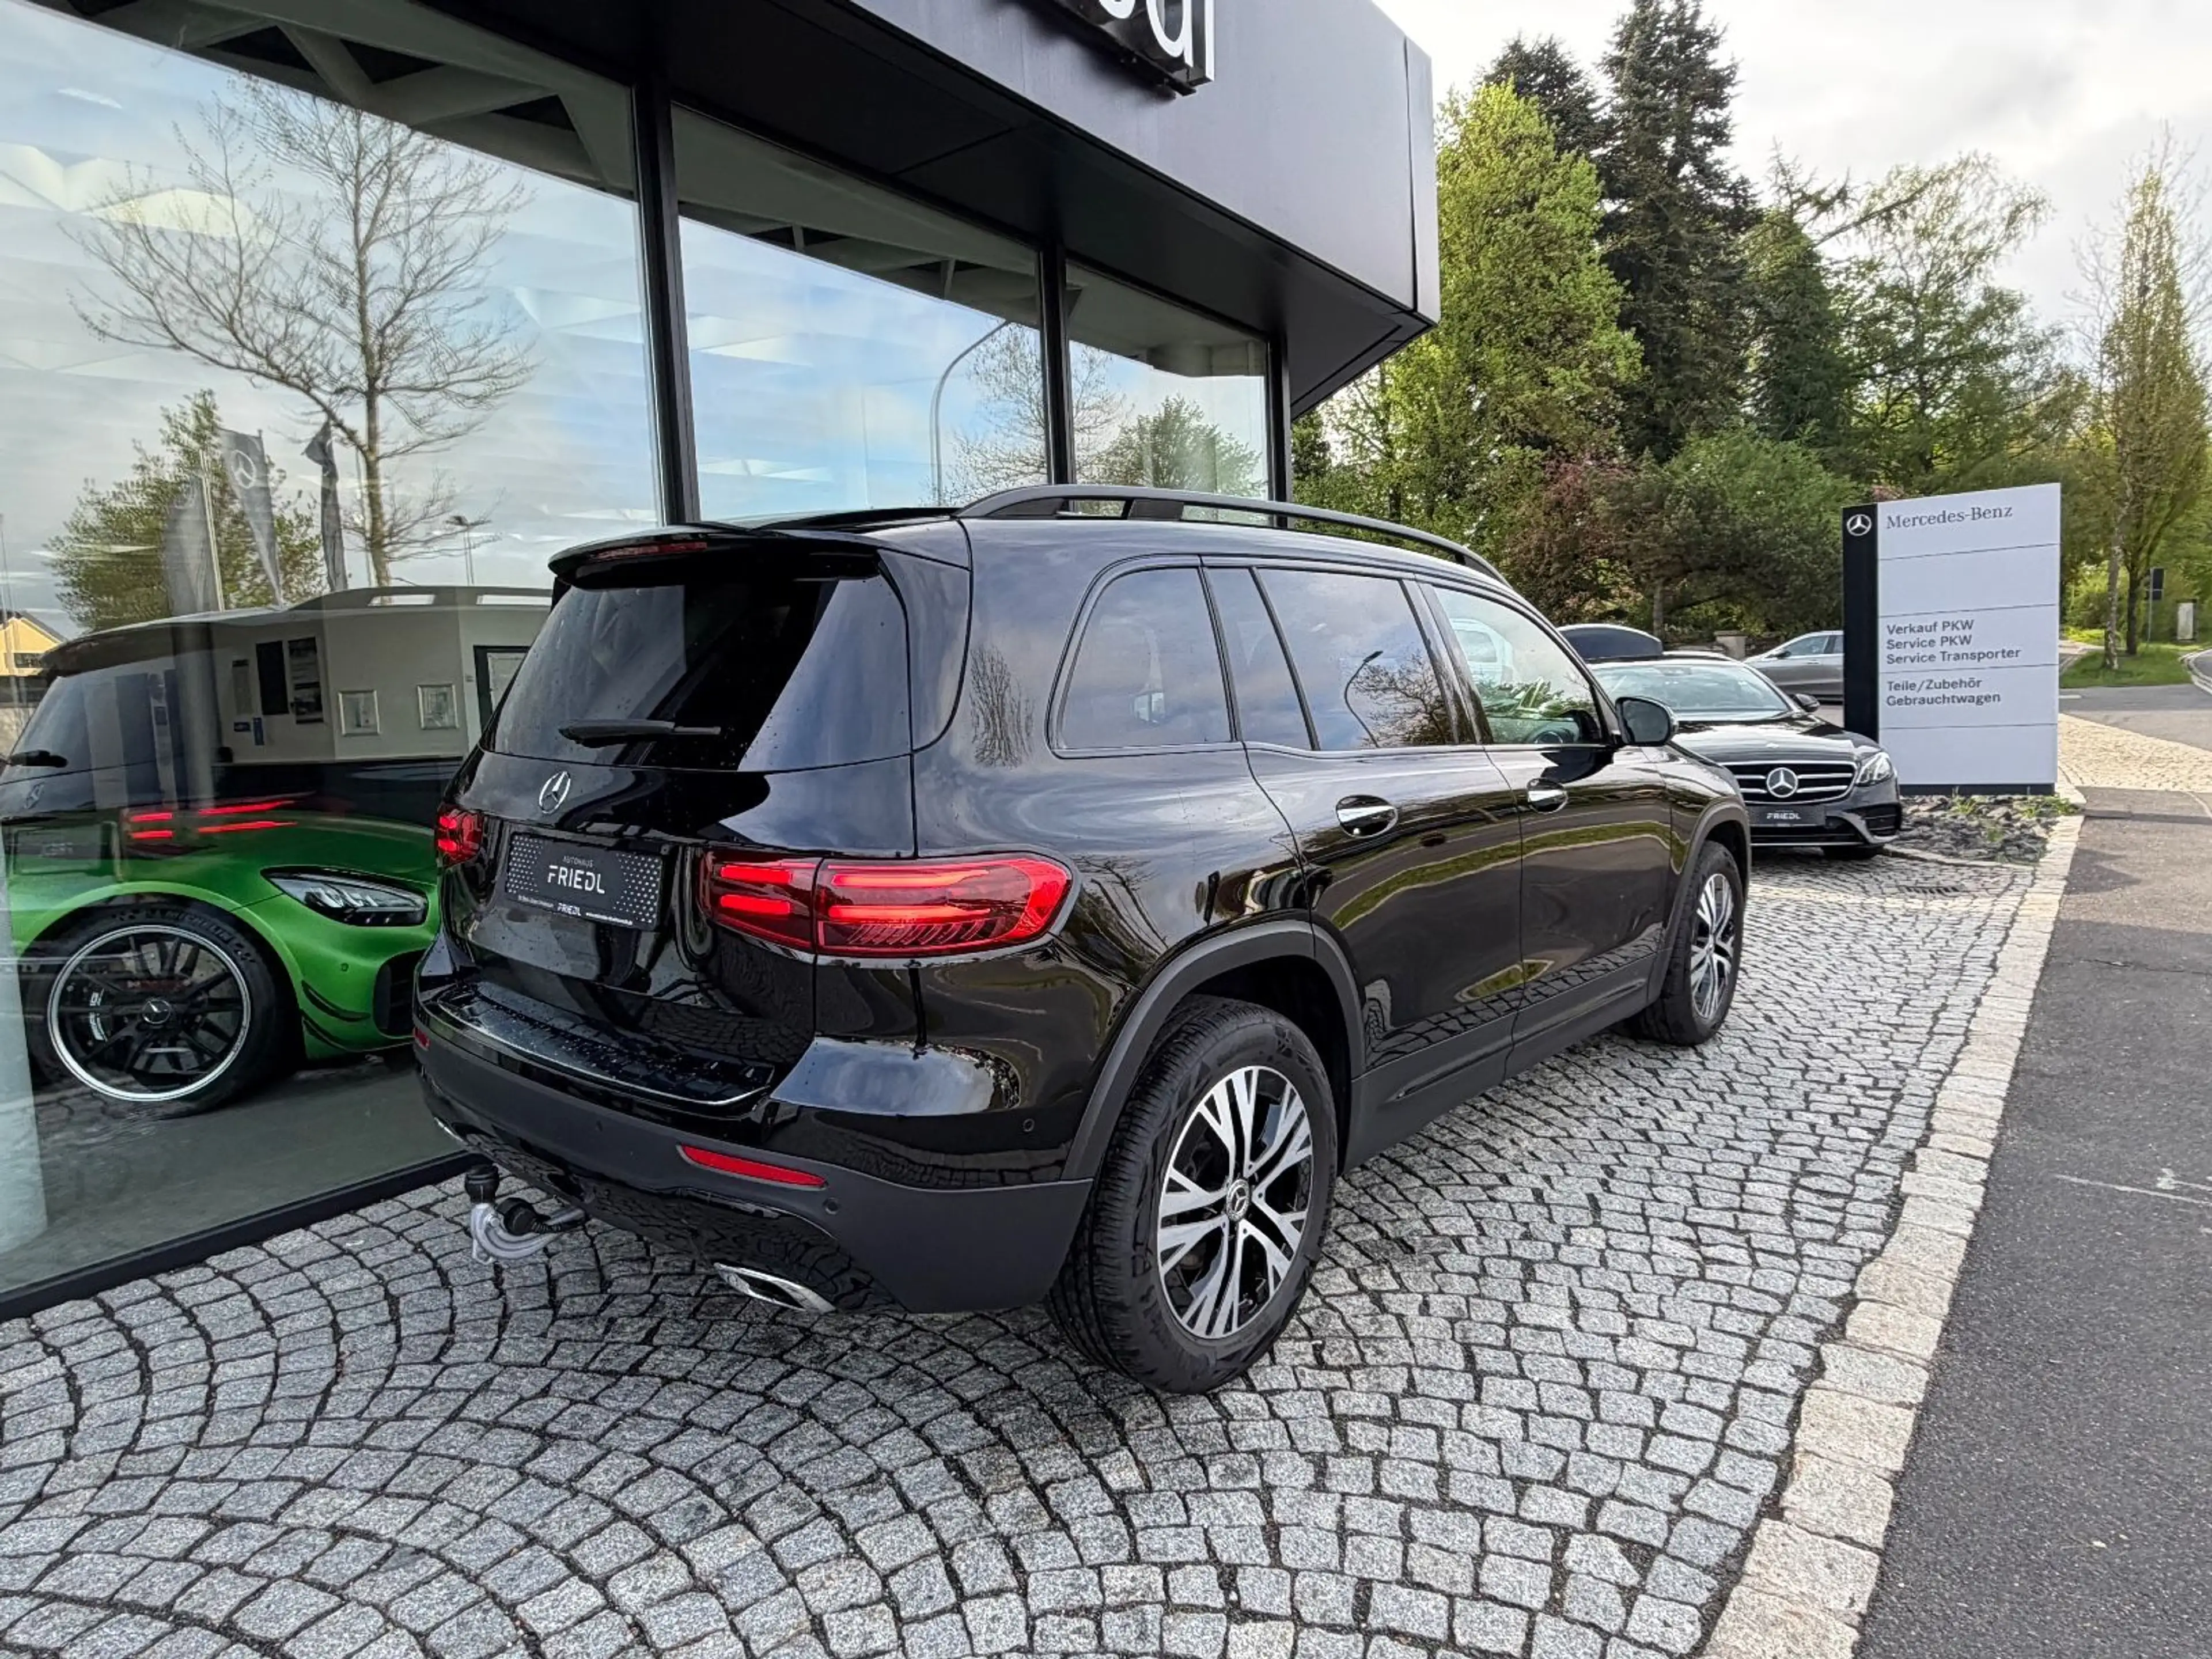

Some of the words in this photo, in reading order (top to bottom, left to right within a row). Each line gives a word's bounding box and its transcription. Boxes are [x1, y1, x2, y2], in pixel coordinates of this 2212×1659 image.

[1887, 506, 2013, 529] Mercedes-Benz
[1887, 621, 1938, 634] Verkauf
[1942, 619, 1975, 631] PKW
[1887, 638, 1936, 650] Service
[1940, 634, 1972, 646] PKW
[1887, 653, 1937, 665] Service
[1940, 648, 2021, 662] Transporter
[1887, 677, 1982, 693] Teile/Zubehör
[1886, 694, 2001, 706] Gebrauchtwagen
[547, 865, 605, 894] FRIEDL
[557, 902, 581, 916] FRIEDL
